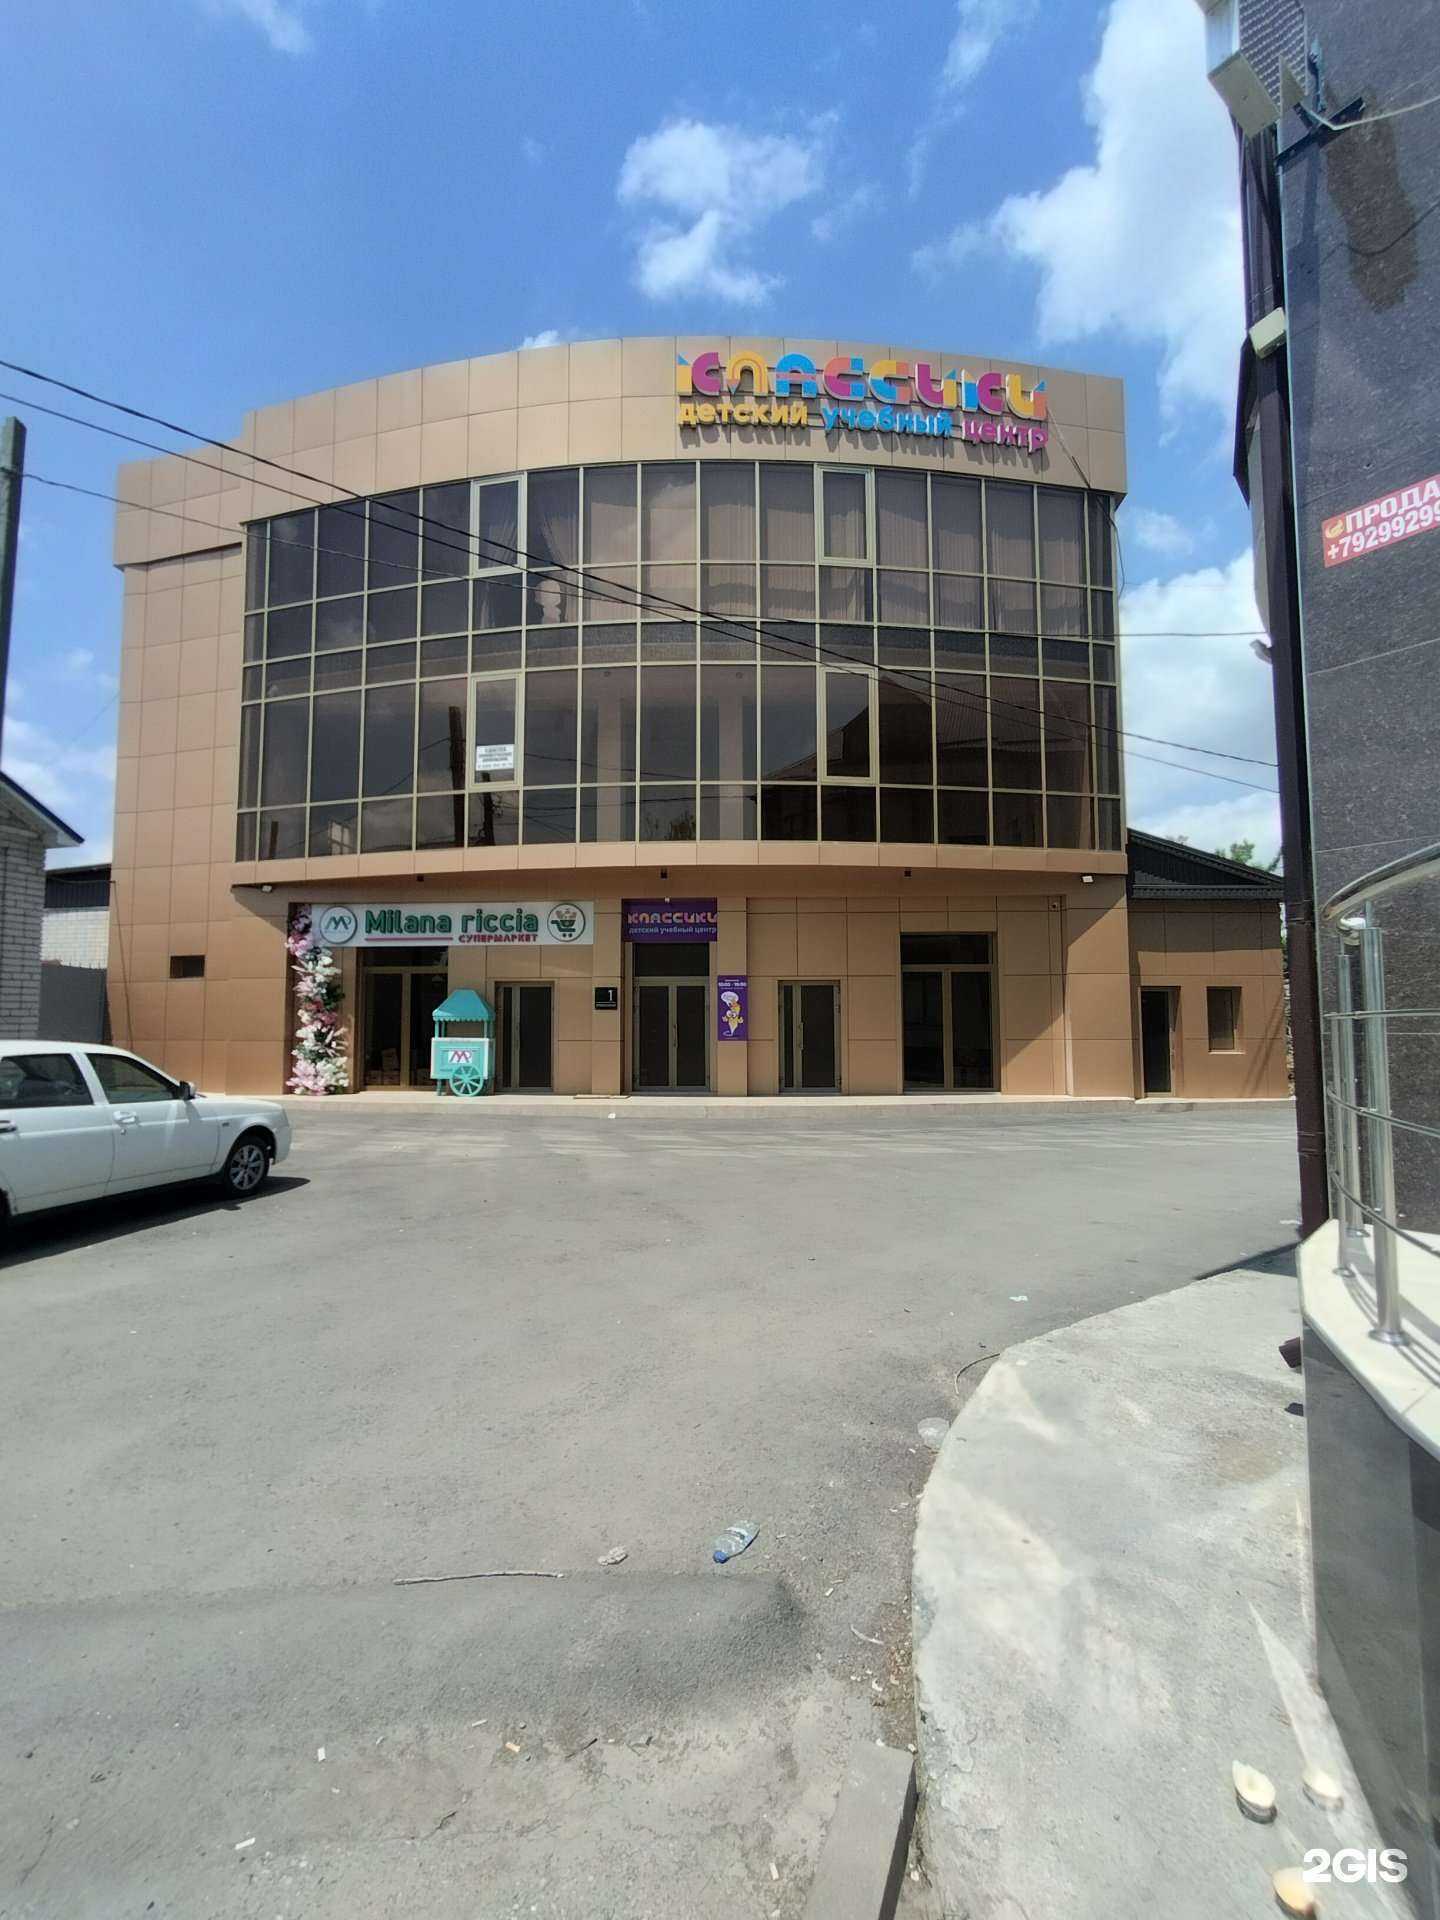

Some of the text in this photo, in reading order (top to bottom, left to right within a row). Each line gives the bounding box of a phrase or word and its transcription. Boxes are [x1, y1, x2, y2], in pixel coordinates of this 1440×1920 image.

[961, 418, 1050, 455] центр
[365, 907, 539, 934] Milana riccia
[458, 933, 538, 943] СУПЕРМАРКЕТ
